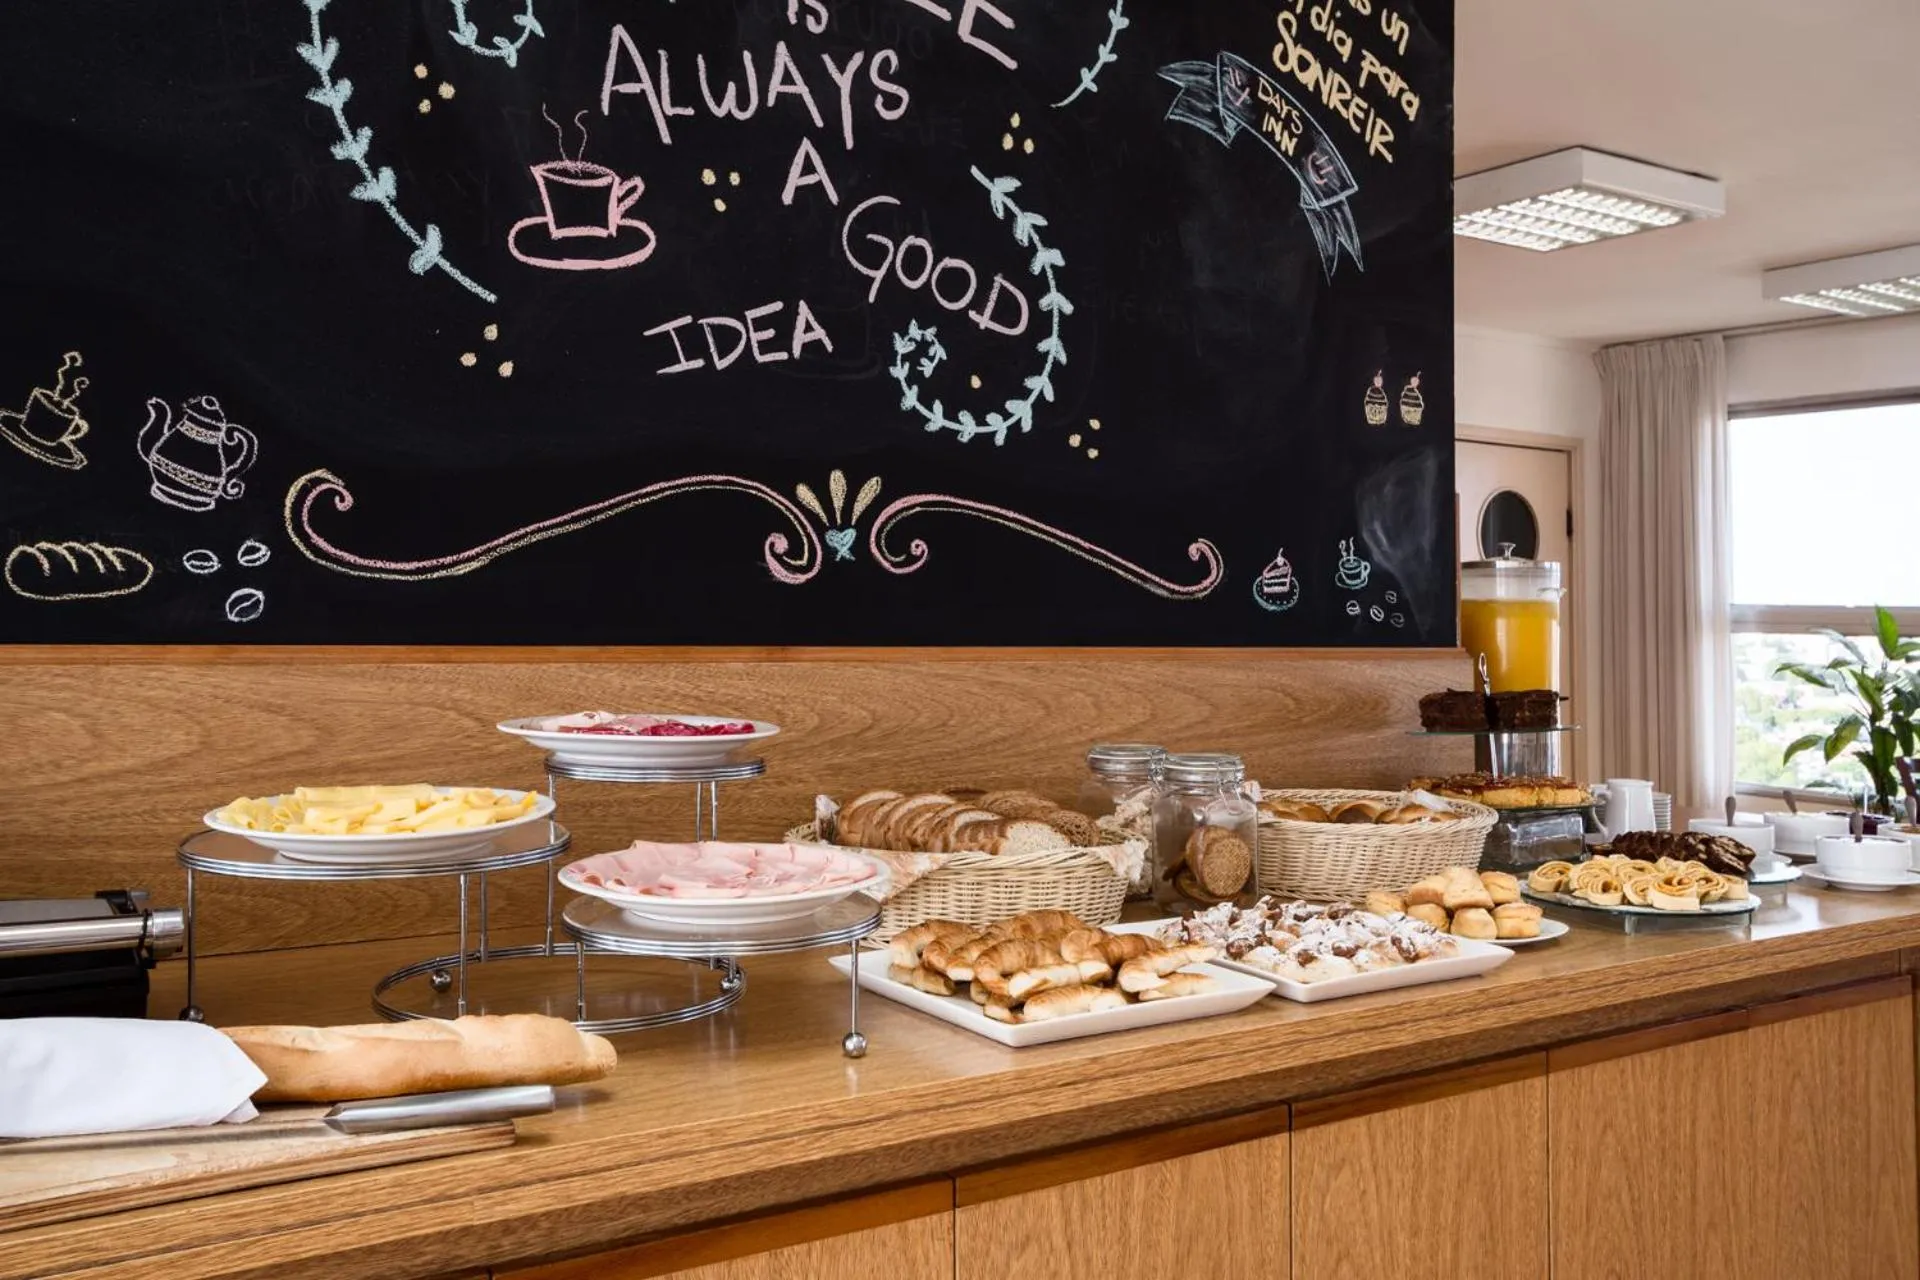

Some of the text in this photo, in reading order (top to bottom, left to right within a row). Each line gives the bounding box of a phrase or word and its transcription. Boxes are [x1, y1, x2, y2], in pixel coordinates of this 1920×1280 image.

[1381, 8, 1409, 56] un
[600, 24, 910, 150] ALWAYS
[1257, 77, 1304, 135] DAYS
[1272, 10, 1396, 164] SONREIR
[1359, 49, 1421, 122] para
[1262, 112, 1299, 157] INN
[781, 137, 839, 206] A
[842, 195, 1030, 336] GOOD
[643, 300, 834, 375] IDEA
